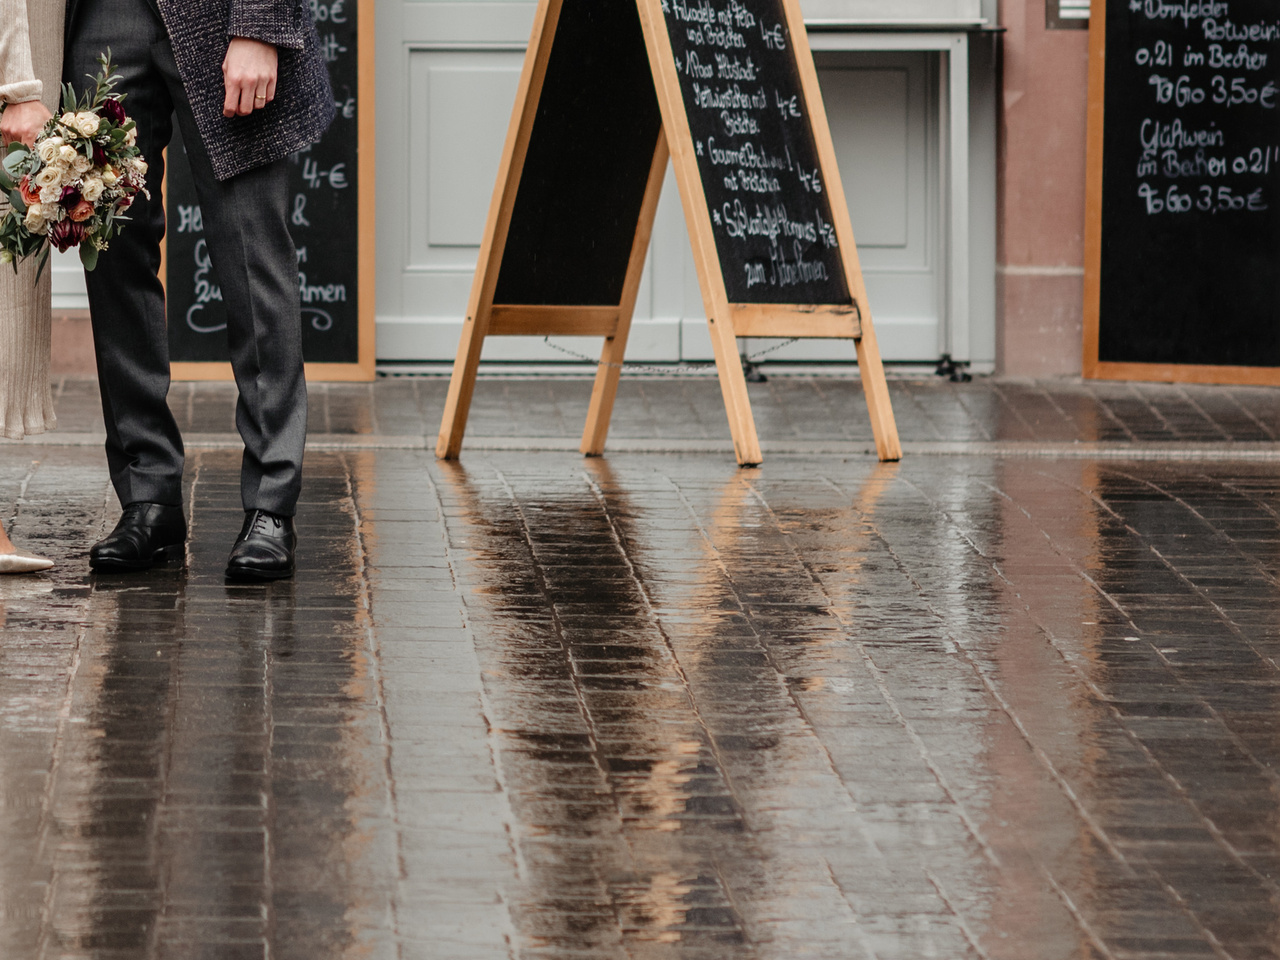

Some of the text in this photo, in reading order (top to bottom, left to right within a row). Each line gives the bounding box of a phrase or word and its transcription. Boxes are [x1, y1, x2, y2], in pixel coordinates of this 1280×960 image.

[718, 3, 733, 27] mit
[732, 0, 756, 29] Feta
[686, 24, 705, 46] und
[704, 23, 747, 49] Brötchen
[1183, 45, 1204, 67] im
[1207, 43, 1267, 70] Becher
[1140, 118, 1224, 160] Glühwein
[1137, 156, 1157, 177] im
